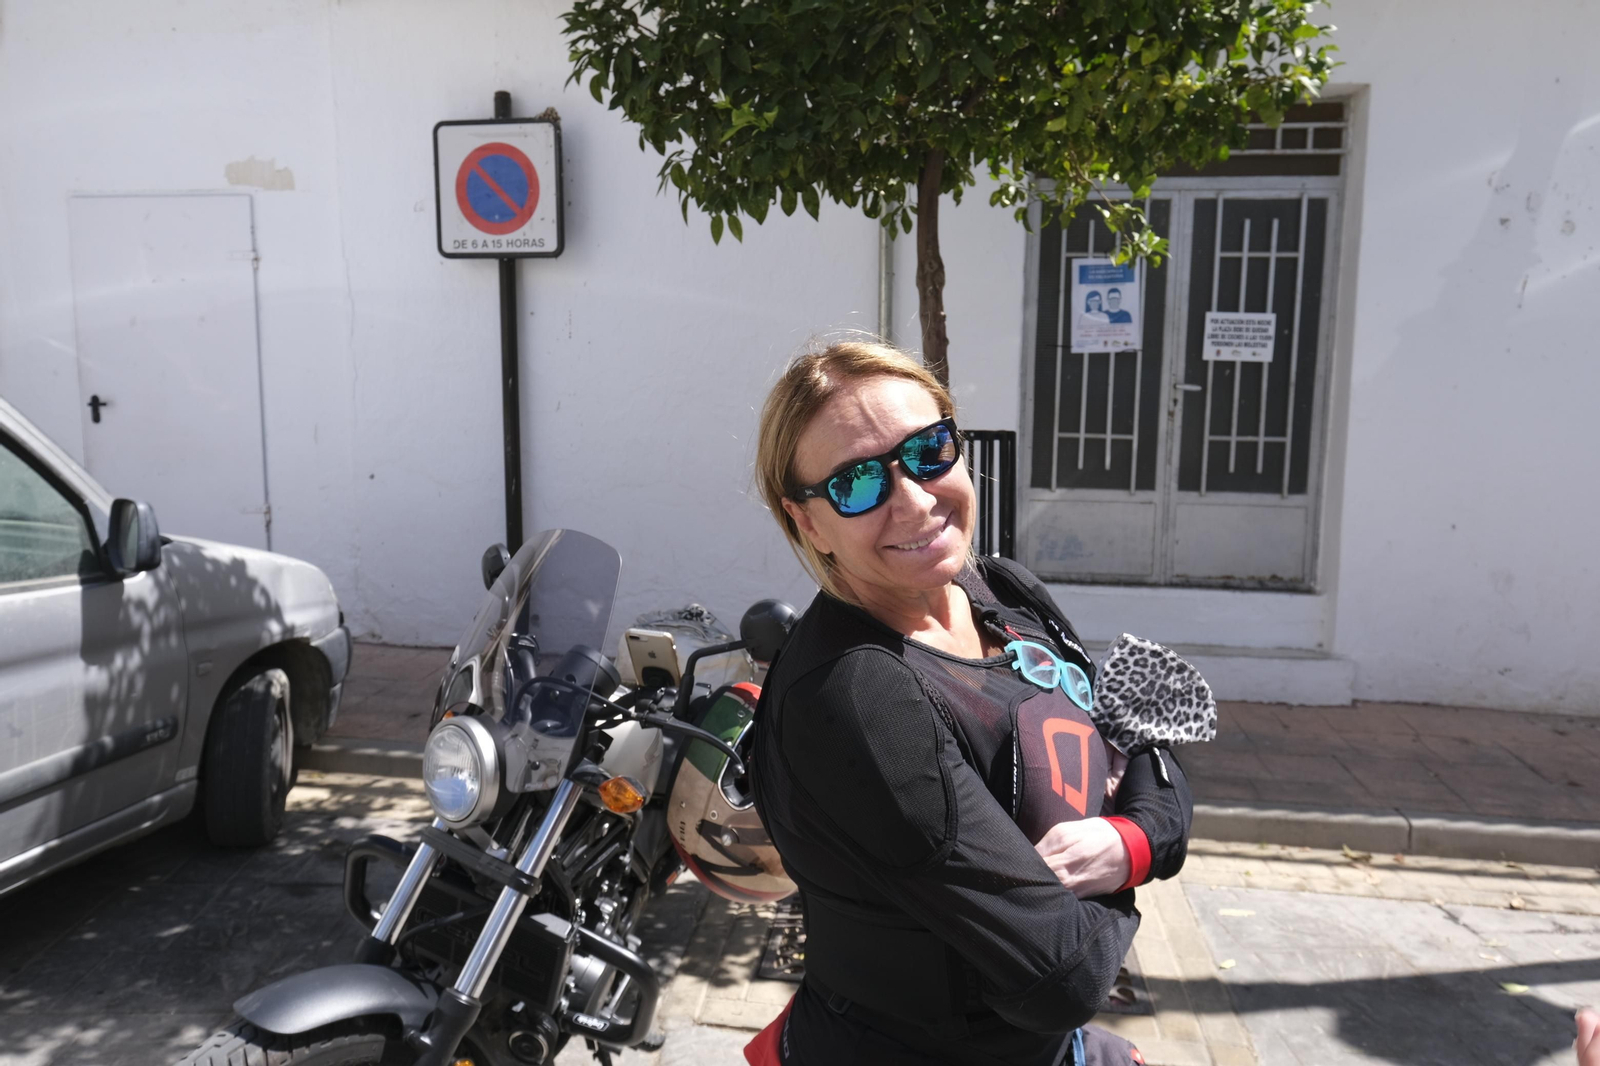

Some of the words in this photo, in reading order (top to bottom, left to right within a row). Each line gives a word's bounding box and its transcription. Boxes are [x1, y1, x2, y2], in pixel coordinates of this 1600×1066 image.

[453, 240, 468, 249] DE
[471, 240, 478, 249] 6
[481, 239, 489, 249] A
[492, 239, 502, 249] 15
[506, 238, 545, 248] HORAS
